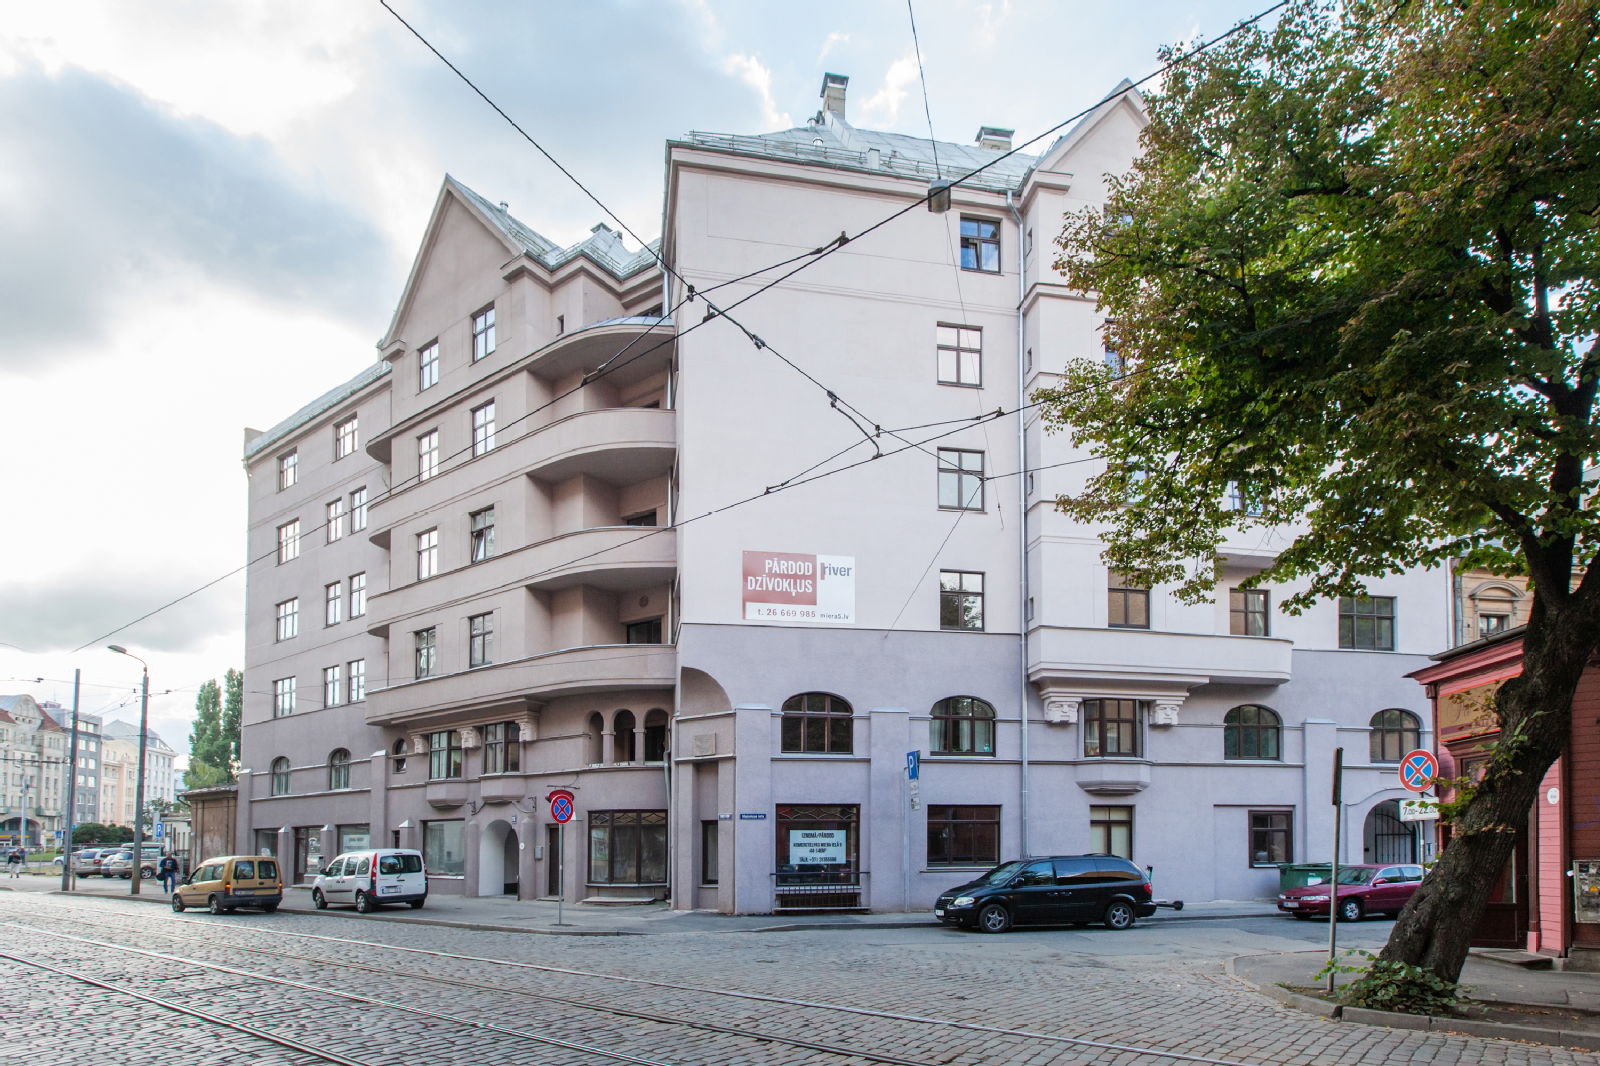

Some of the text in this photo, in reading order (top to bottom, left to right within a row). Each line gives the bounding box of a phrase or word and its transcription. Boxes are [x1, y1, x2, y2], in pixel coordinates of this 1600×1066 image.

[765, 557, 813, 576] PĀRDOD
[823, 563, 853, 577] river
[747, 574, 813, 597] DZĪVOKĻUS
[766, 608, 777, 616] 26
[780, 609, 797, 617] 669
